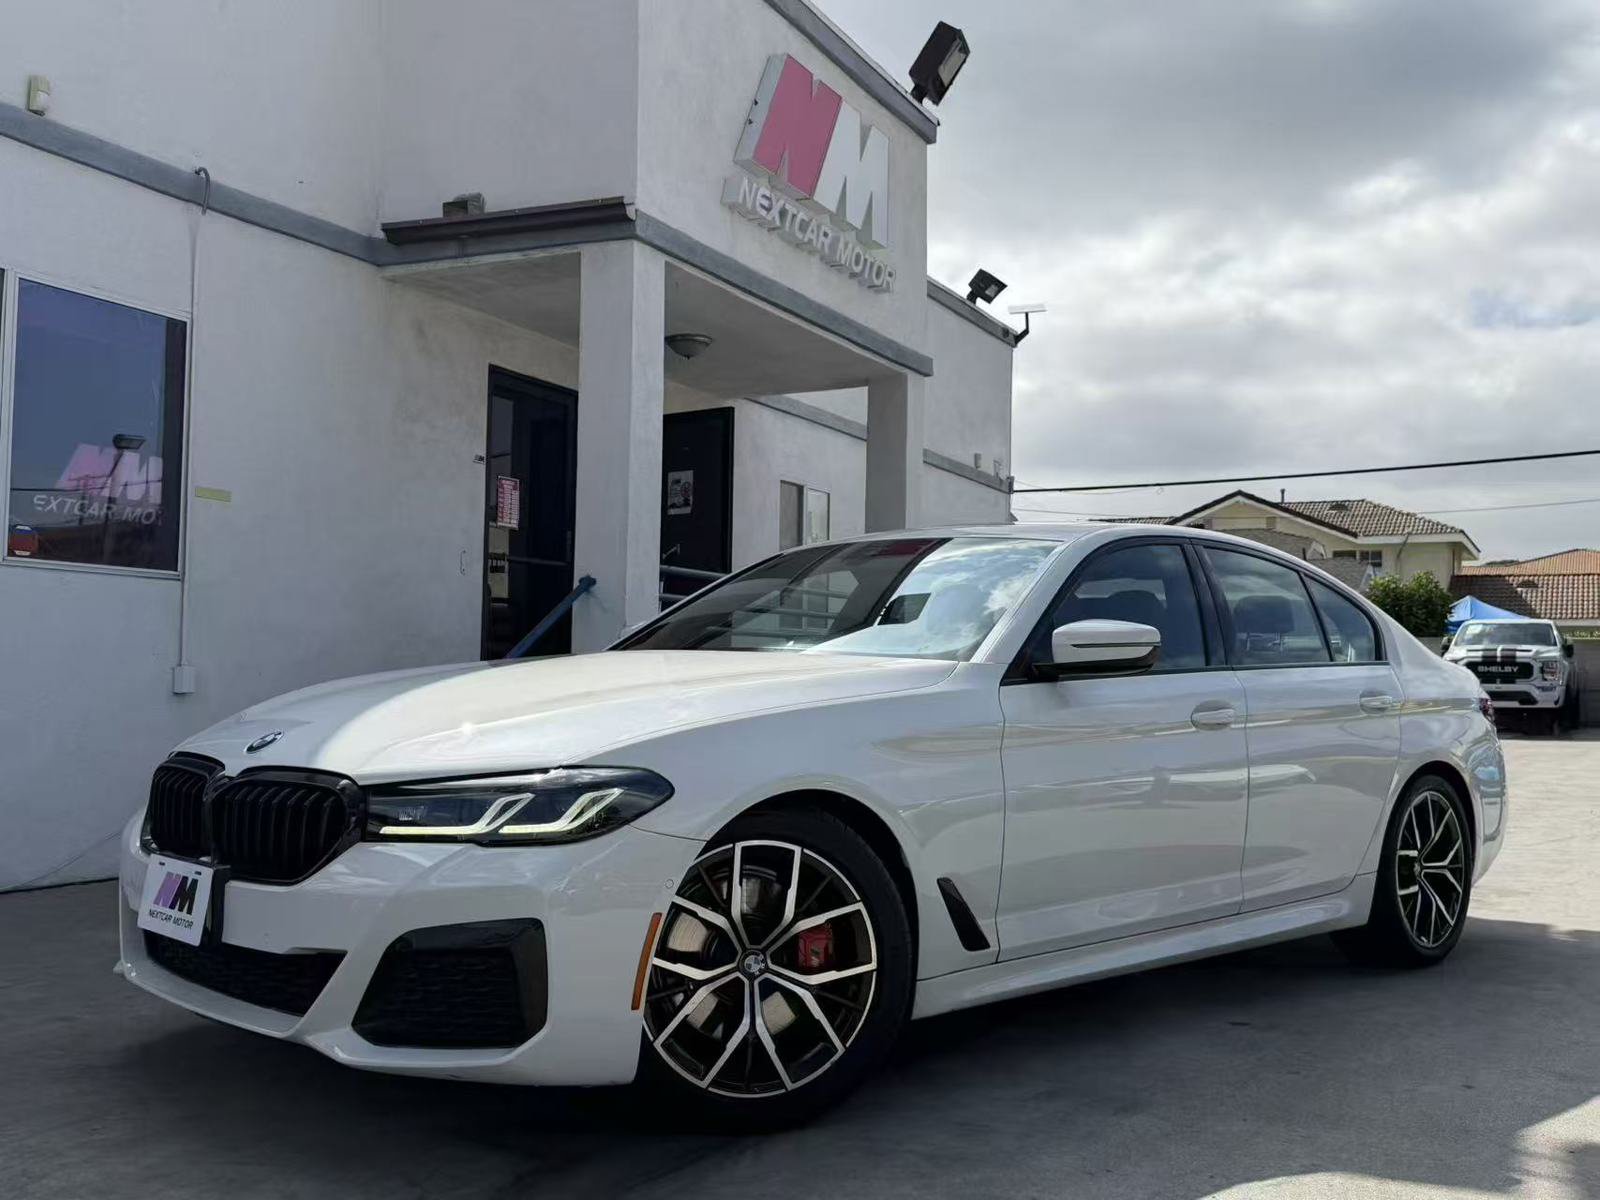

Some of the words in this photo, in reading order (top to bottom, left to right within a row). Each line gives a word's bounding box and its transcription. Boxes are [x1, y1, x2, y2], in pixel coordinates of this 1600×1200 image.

[737, 175, 834, 255] NEXTCAR
[835, 241, 896, 289] MOTOR
[1477, 665, 1519, 673] SHELBY
[149, 908, 173, 923] NEXTCAR
[172, 915, 194, 930] MOTOR
